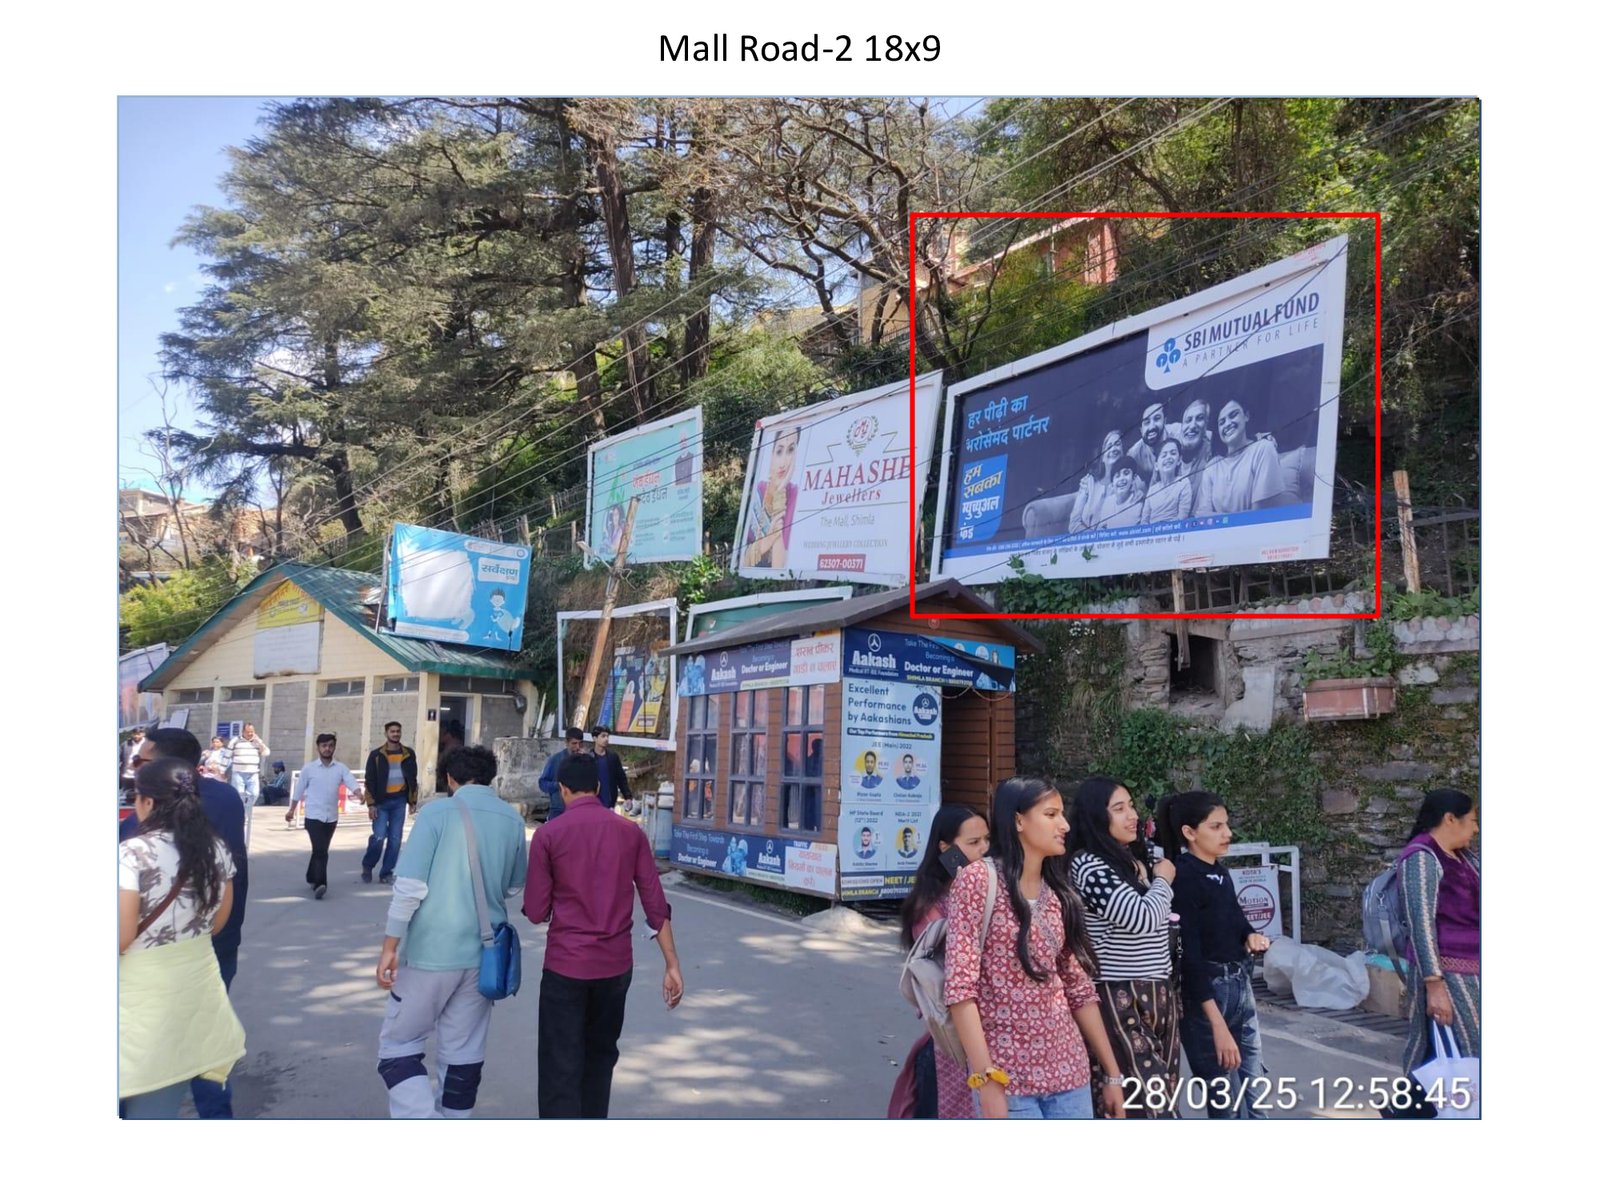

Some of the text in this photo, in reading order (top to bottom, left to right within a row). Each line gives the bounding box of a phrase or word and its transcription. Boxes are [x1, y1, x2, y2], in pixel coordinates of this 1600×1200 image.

[1184, 292, 1320, 352] SBI MUTUAL FUND
[1182, 318, 1319, 368] A PARTNER FOR LIFE
[967, 395, 1028, 429] हर पीढ़ी का
[966, 414, 1050, 453] भरोसेमंद पार्टनर
[964, 463, 983, 485] हम
[963, 470, 1003, 498] सबका
[822, 488, 881, 505] Jewellers
[820, 516, 833, 528] The
[851, 512, 876, 527] Shimla
[852, 650, 896, 669] Aakash
[926, 651, 950, 662] Becoming
[711, 666, 736, 681] Aakash
[741, 663, 758, 674] Doctor
[765, 661, 788, 675] Engineer
[904, 662, 974, 678] Doctor or Engineer
[848, 683, 889, 696] Excellent
[848, 697, 907, 712] Performance
[913, 705, 937, 715] Aakash
[848, 711, 911, 726] by Aakashians
[758, 852, 780, 866] Aakash
